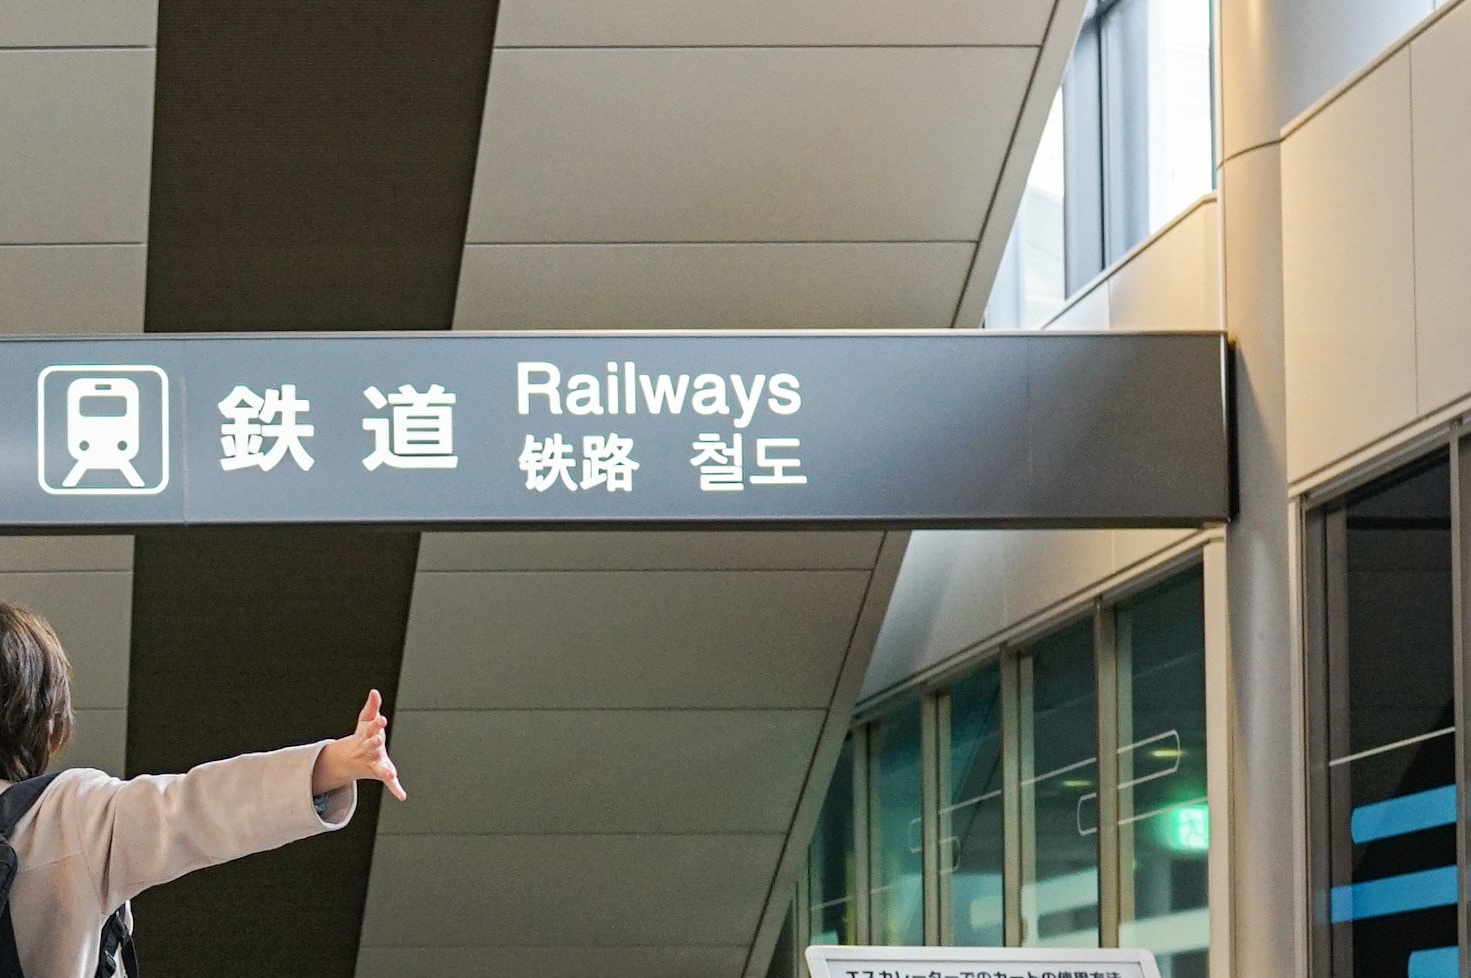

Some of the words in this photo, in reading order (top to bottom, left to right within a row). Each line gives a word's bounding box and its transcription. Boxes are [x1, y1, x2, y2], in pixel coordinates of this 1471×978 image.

[517, 361, 801, 427] Railways
[217, 384, 458, 472] 鉄道
[517, 433, 640, 492] 铁路
[690, 433, 808, 492] 철도
